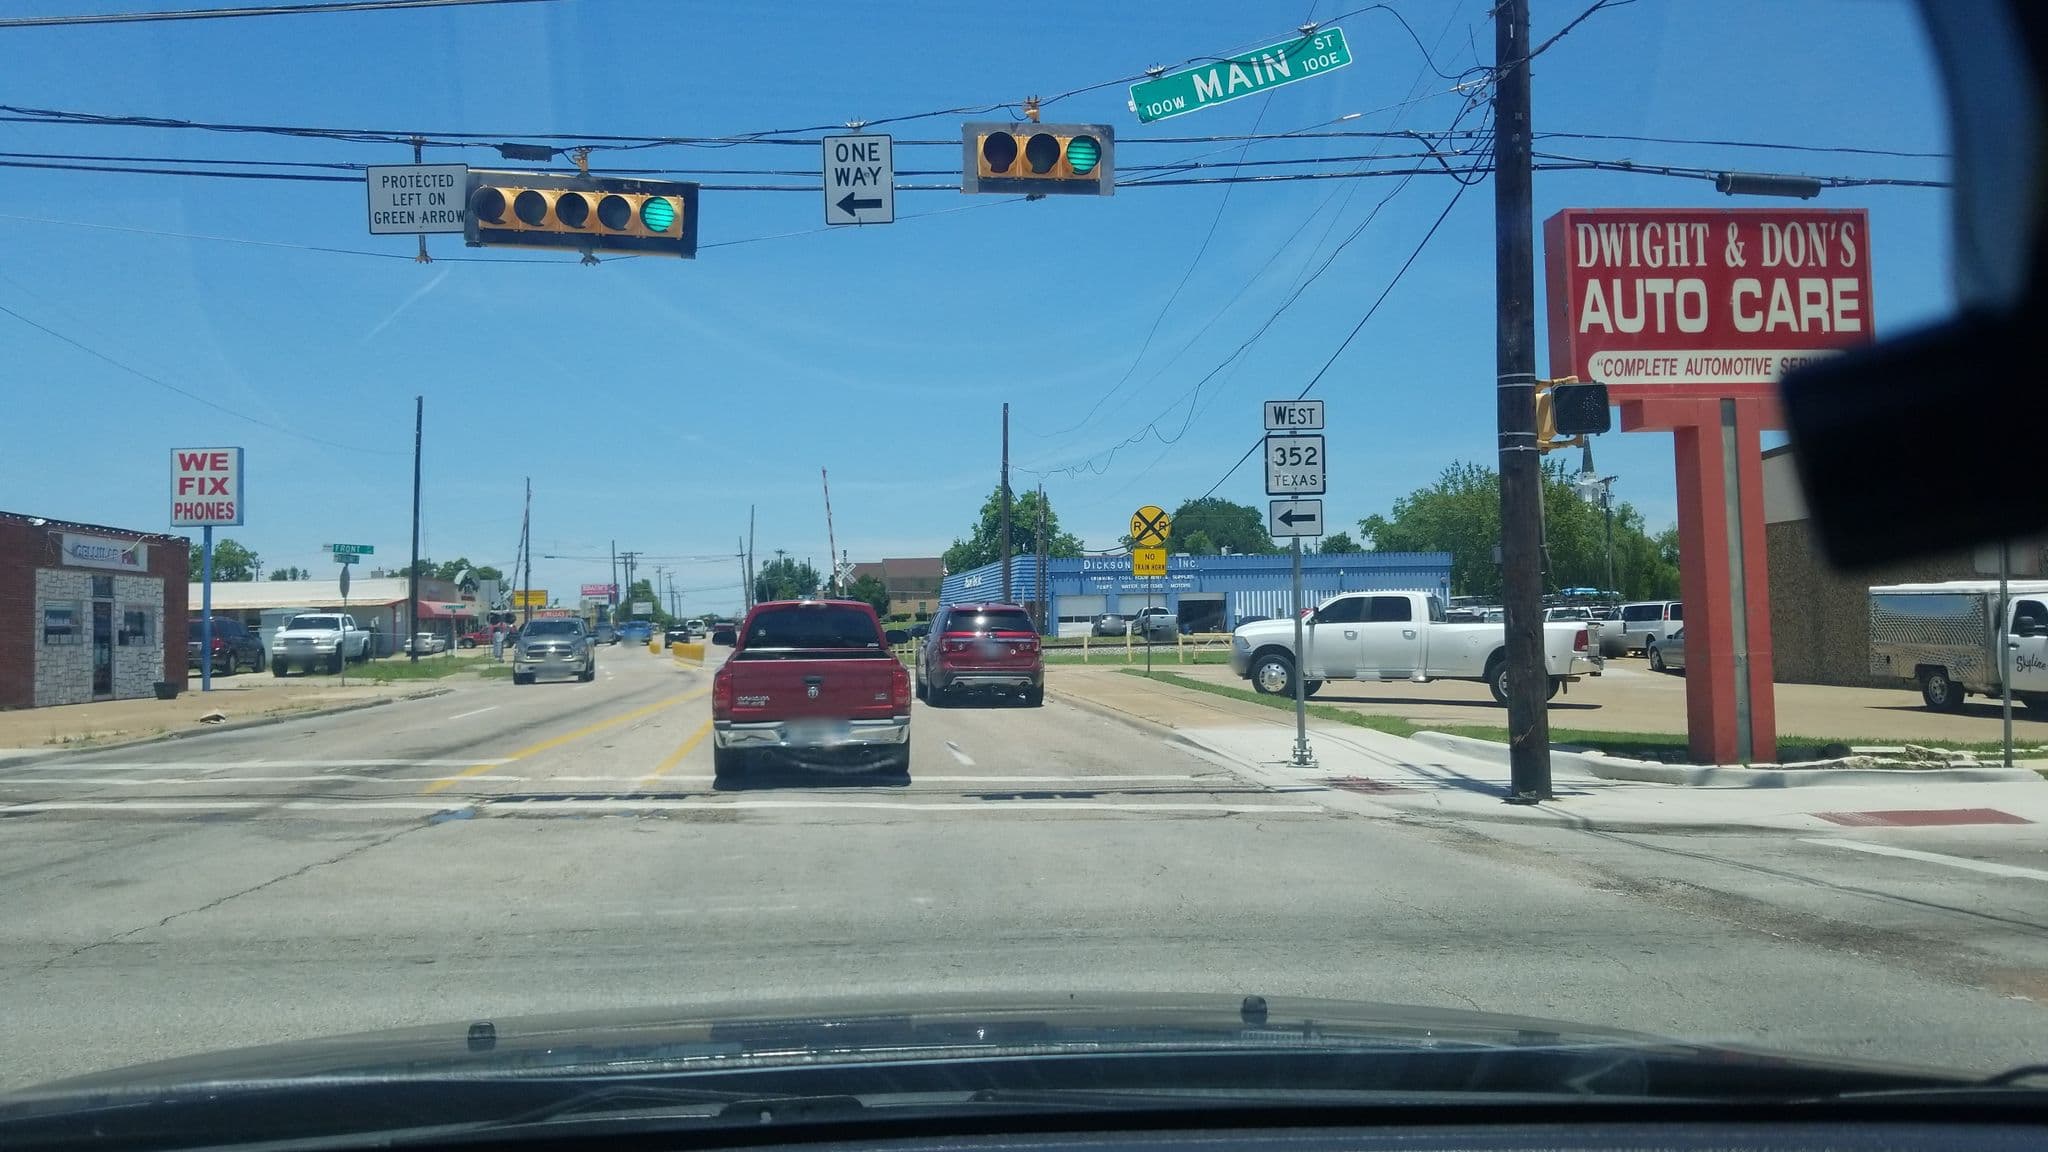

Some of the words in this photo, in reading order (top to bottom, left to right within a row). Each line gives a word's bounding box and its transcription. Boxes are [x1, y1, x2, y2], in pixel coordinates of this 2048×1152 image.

[1192, 49, 1291, 103] MAIN
[1314, 35, 1333, 50] ST
[1302, 52, 1340, 73] 100E
[1146, 95, 1185, 117] 100W
[836, 142, 880, 162] ONE
[382, 174, 454, 188] PROTECTED
[835, 167, 882, 187] WAY
[393, 193, 421, 206] LEFT
[429, 192, 446, 205] ON
[374, 211, 415, 224] GREEN
[421, 210, 465, 223] ARROW
[1576, 222, 1709, 268] DWIGHT
[1725, 221, 1747, 268] &
[1761, 221, 1856, 268] DON'S
[1579, 278, 1709, 334] AUTO
[1732, 278, 1861, 333] CARE
[1685, 357, 1772, 376] AUTOMOTIVE
[1273, 406, 1315, 425] WEST
[178, 453, 229, 471] WE
[1275, 446, 1317, 466] 352
[178, 477, 229, 496] FIX
[1274, 474, 1318, 487] TEXAS
[174, 502, 235, 520] PHONES
[1134, 521, 1142, 531] R
[1159, 521, 1167, 531] R
[335, 544, 360, 553] FRONT
[1144, 553, 1155, 561] NO
[1083, 559, 1131, 570] DICKSON
[1135, 563, 1150, 571] TRAIN
[1151, 563, 1165, 571] HORN
[2016, 653, 2047, 674] Skyline
